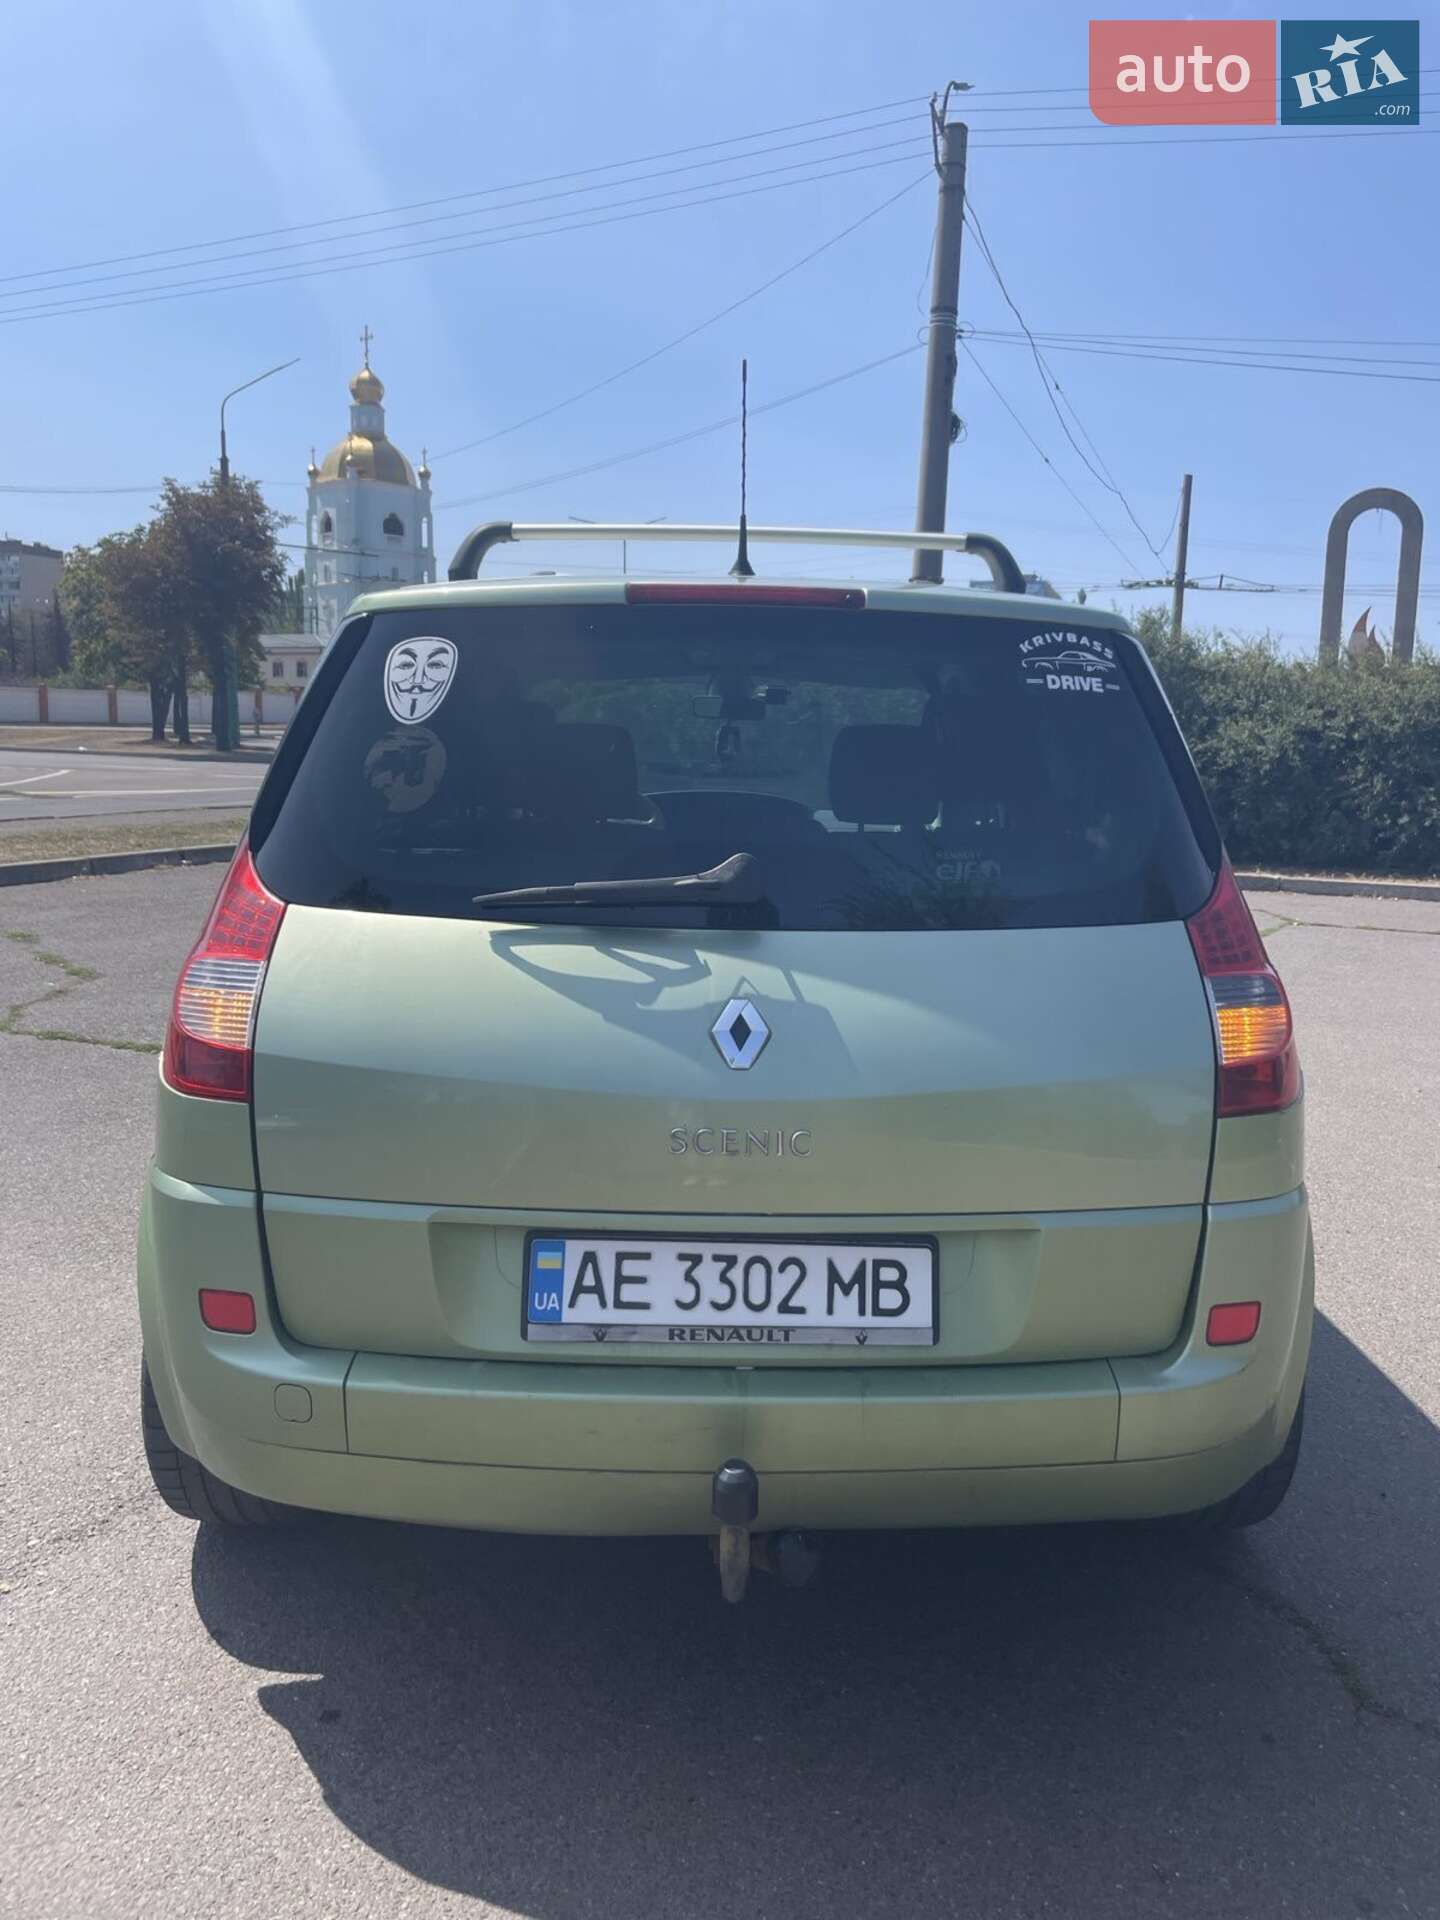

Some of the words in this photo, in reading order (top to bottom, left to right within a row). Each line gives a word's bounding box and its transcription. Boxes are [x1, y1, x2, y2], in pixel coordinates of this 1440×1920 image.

[1019, 631, 1114, 660] KRIVBASS
[1046, 674, 1105, 693] DRIVE
[668, 1127, 812, 1157] SCENIC
[567, 1250, 652, 1310] AE
[675, 1253, 807, 1315] 3302
[826, 1257, 911, 1318] MB
[534, 1292, 560, 1311] UA
[668, 1327, 797, 1342] RENAULT
